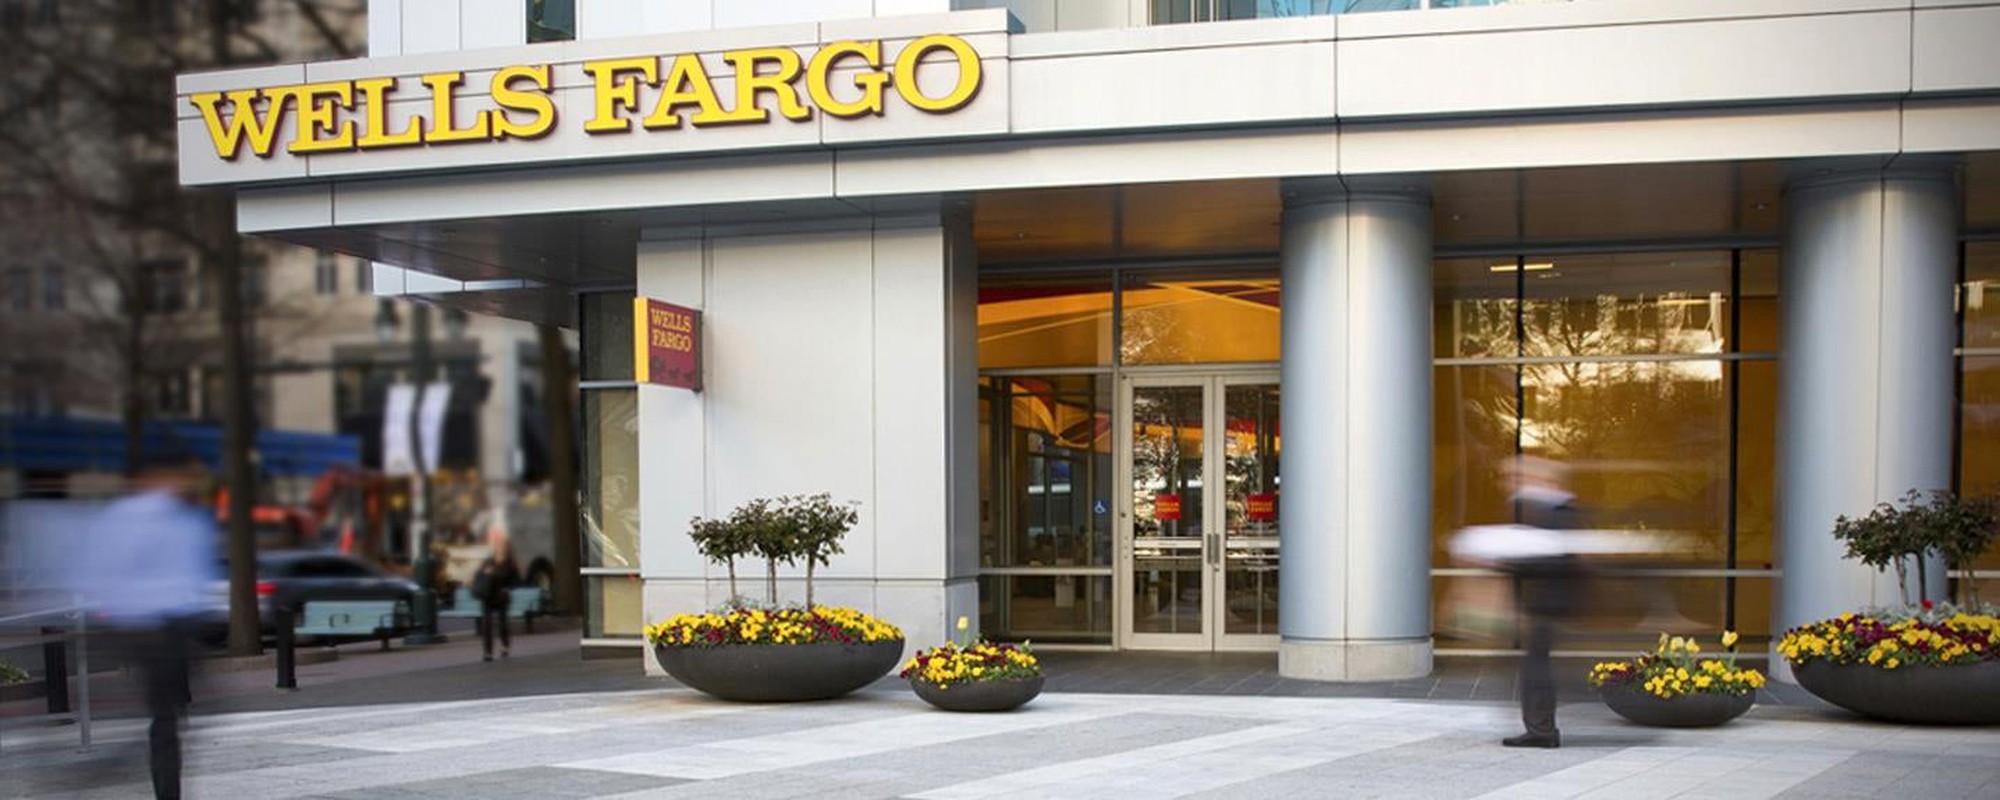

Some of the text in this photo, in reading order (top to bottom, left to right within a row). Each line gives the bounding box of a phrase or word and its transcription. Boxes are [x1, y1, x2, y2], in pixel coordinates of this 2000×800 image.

[190, 34, 983, 160] WELLS FARGO
[651, 308, 692, 333] WELLS
[652, 328, 692, 352] FARGO
